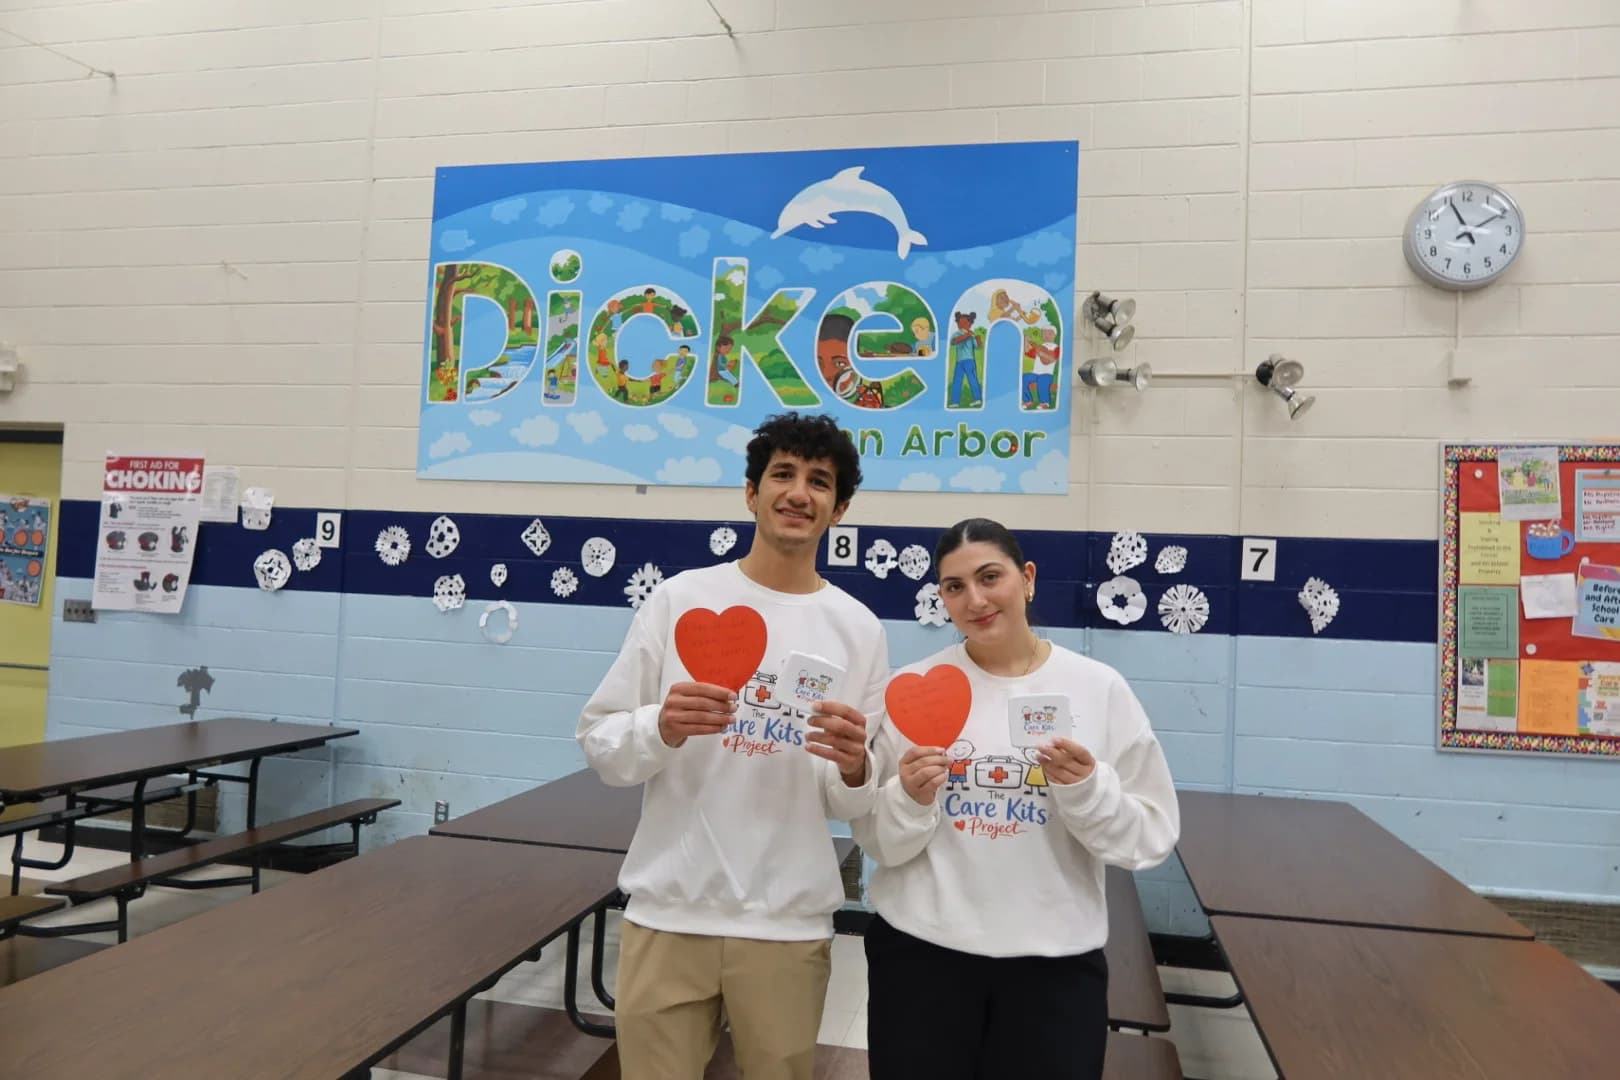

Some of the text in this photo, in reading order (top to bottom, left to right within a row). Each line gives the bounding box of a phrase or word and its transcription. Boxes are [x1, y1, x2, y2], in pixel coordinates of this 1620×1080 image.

[1462, 191, 1473, 202] 12
[1486, 195, 1490, 206] 1
[1424, 228, 1432, 240] 9
[1505, 225, 1512, 236] 3
[1430, 246, 1437, 257] 8
[1499, 243, 1507, 255] 4
[1445, 258, 1452, 270] 7
[1464, 262, 1471, 274] 6
[1484, 256, 1492, 268] 5
[427, 250, 1063, 411] Dicken
[901, 422, 1047, 459] Arbor
[130, 460, 180, 469] FIRST AID FOR
[106, 469, 200, 491] CHOKING
[322, 520, 335, 541] 9
[835, 535, 851, 558] 8
[1250, 547, 1269, 572] 7
[1592, 603, 1619, 614] School
[1594, 614, 1614, 624] Care
[752, 708, 765, 719] The
[721, 717, 803, 746] are Kits
[732, 735, 782, 757] Project
[988, 790, 1005, 800] The
[945, 793, 1047, 825] Care Kits
[969, 816, 1028, 840] Project
